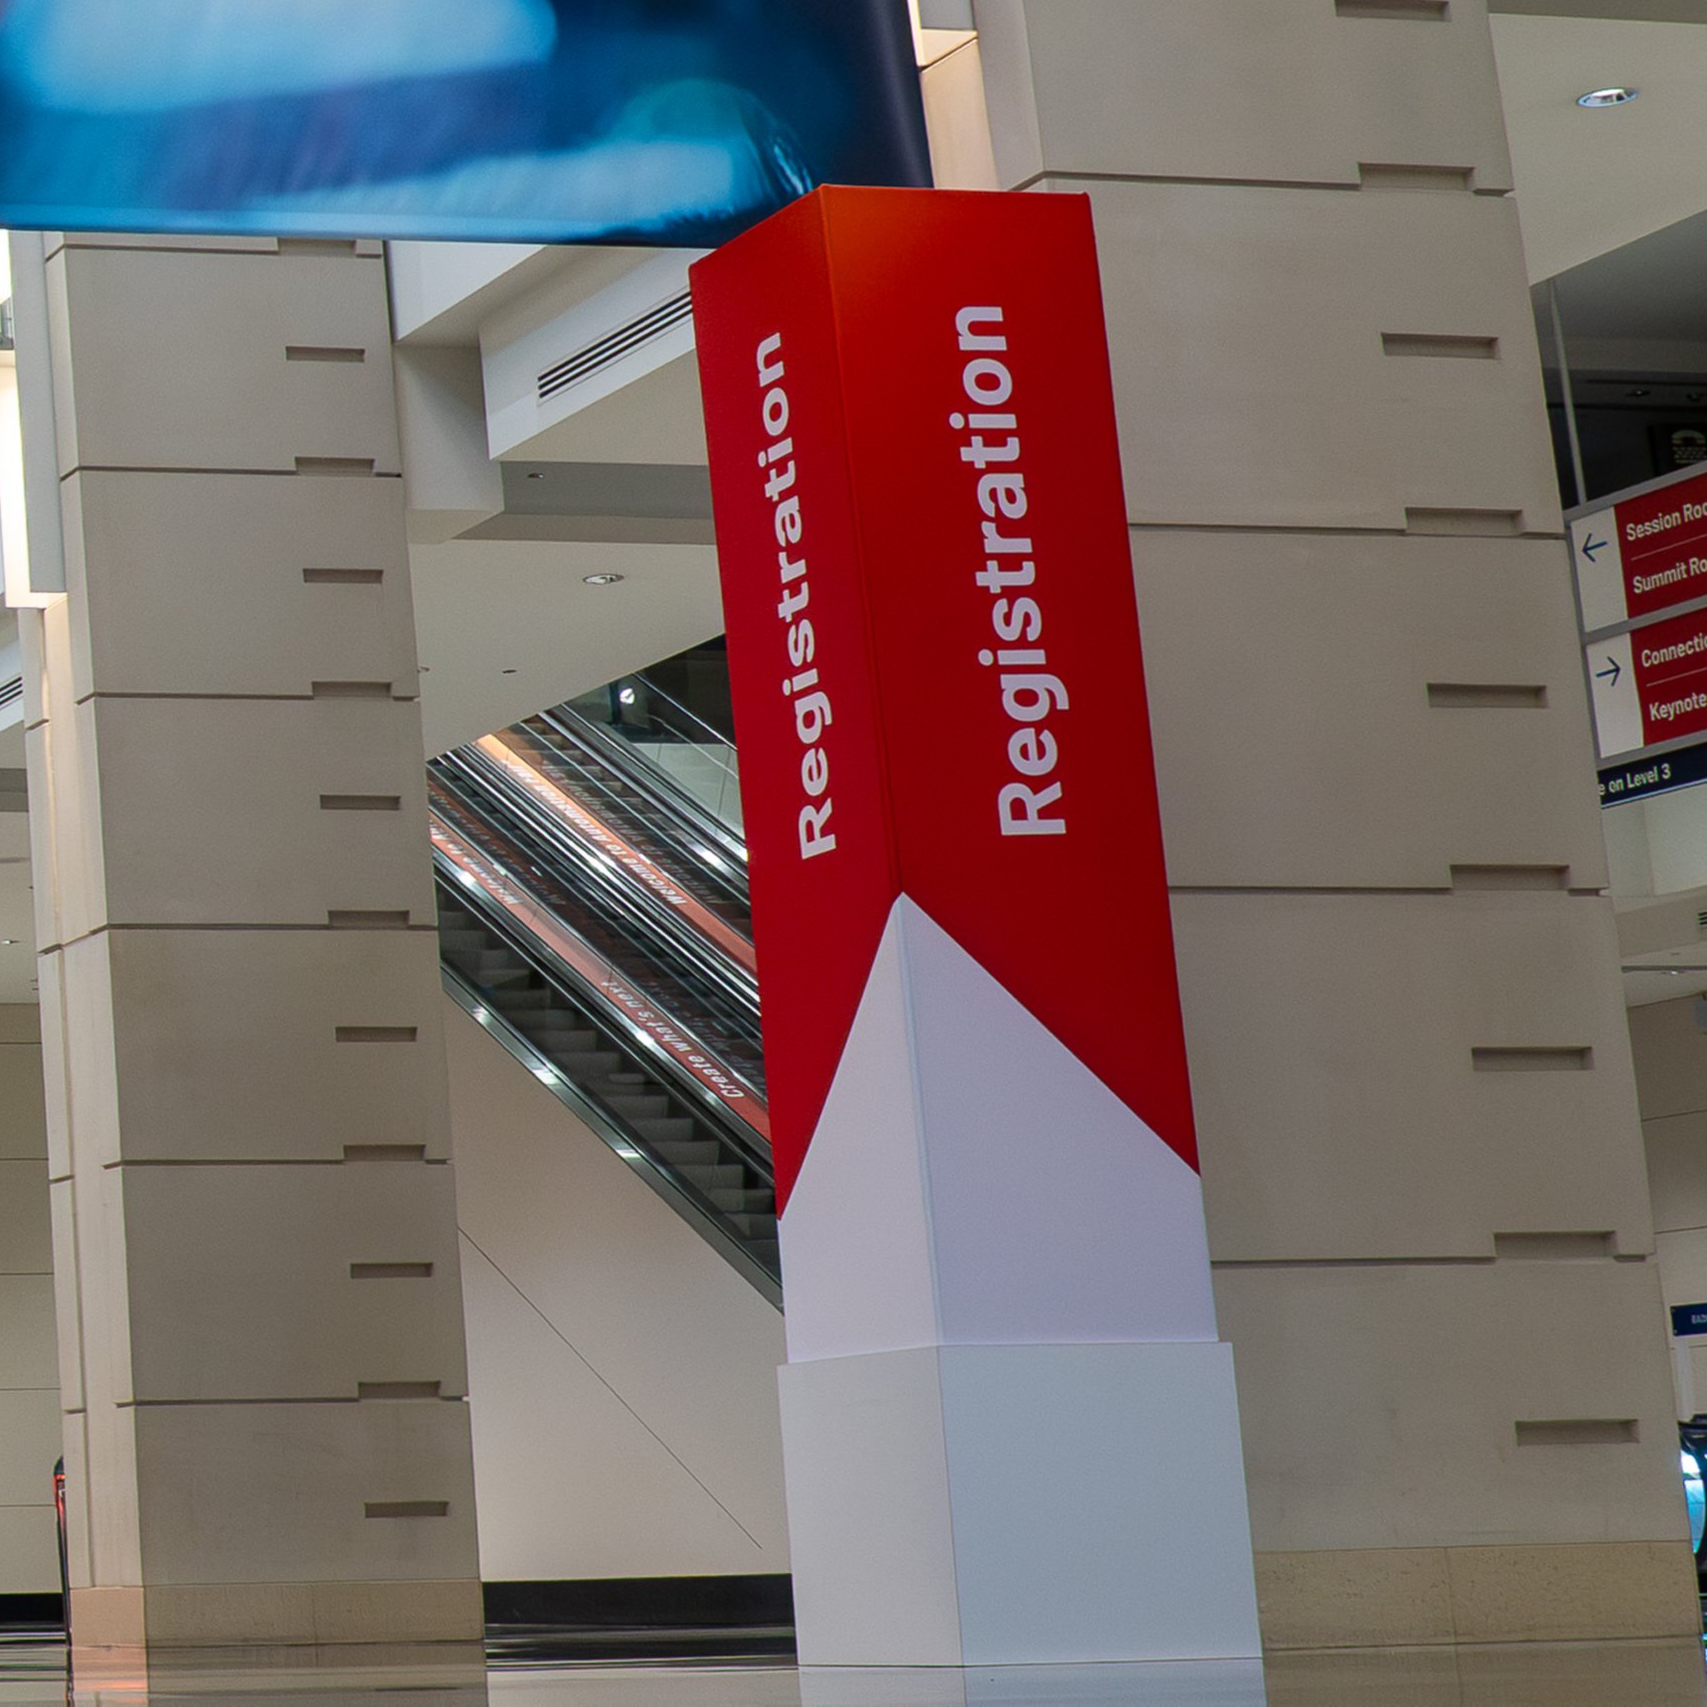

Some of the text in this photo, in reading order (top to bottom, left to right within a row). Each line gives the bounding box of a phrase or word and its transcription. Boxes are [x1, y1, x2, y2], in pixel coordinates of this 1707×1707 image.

[1626, 511, 1681, 541] Session
[755, 332, 837, 859] Registration
[949, 306, 1069, 836] Registration
[1633, 561, 1688, 594] Summit
[1608, 778, 1624, 793] on
[1626, 765, 1659, 789] Level
[1661, 763, 1671, 779] 3
[601, 980, 745, 1098] Create what's next
